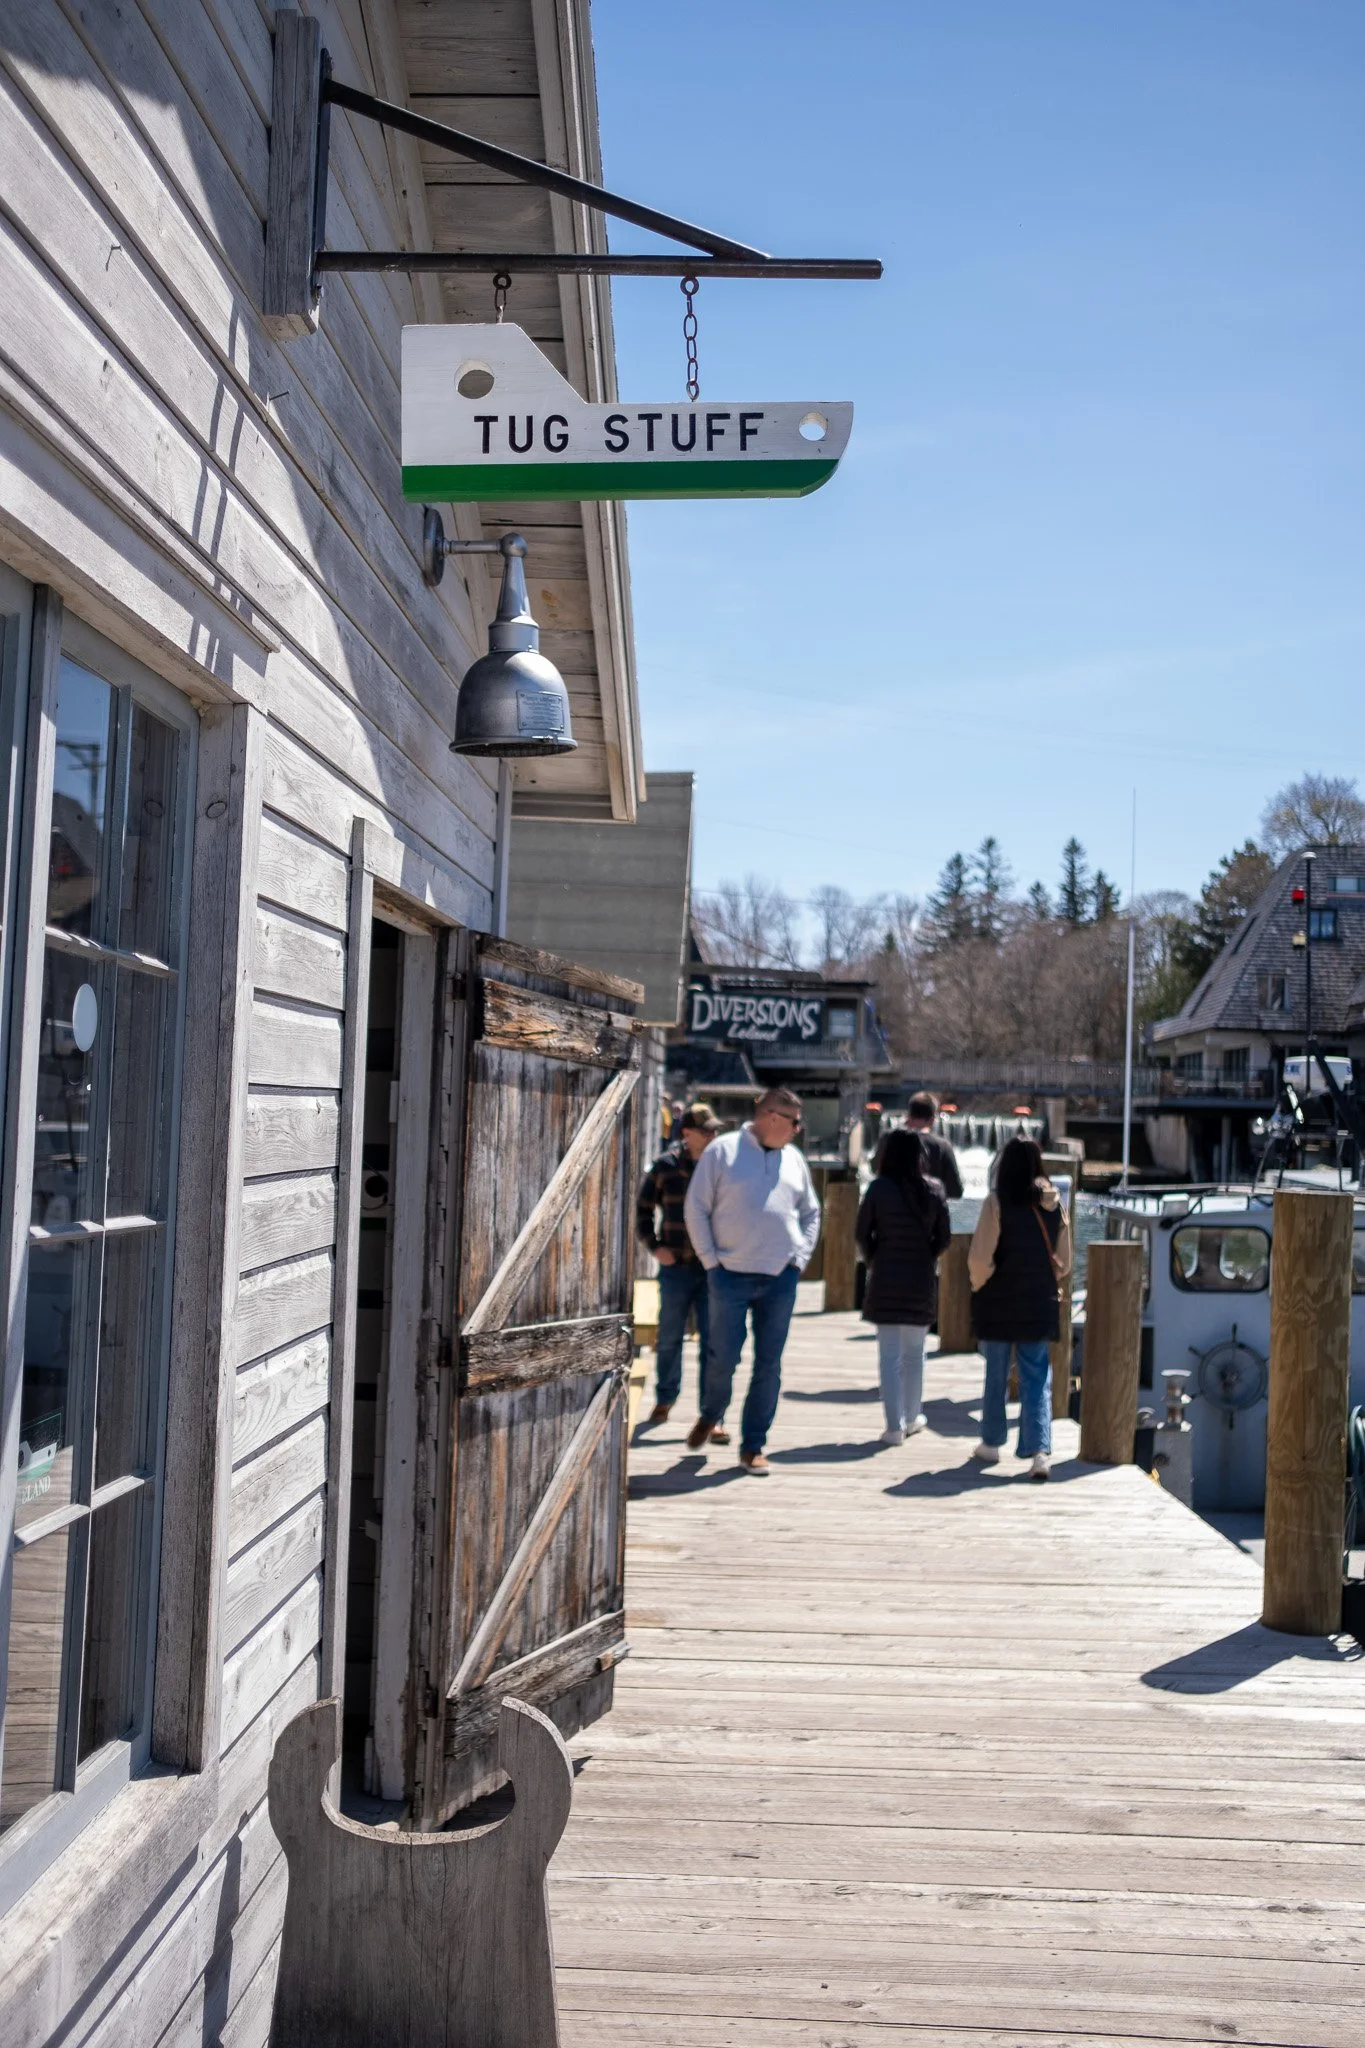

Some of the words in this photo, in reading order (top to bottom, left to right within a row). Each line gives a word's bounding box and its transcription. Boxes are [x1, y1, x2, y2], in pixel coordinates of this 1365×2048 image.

[473, 414, 570, 454] TUG
[604, 411, 766, 453] STUFF
[691, 993, 821, 1040] DIVERSIONS
